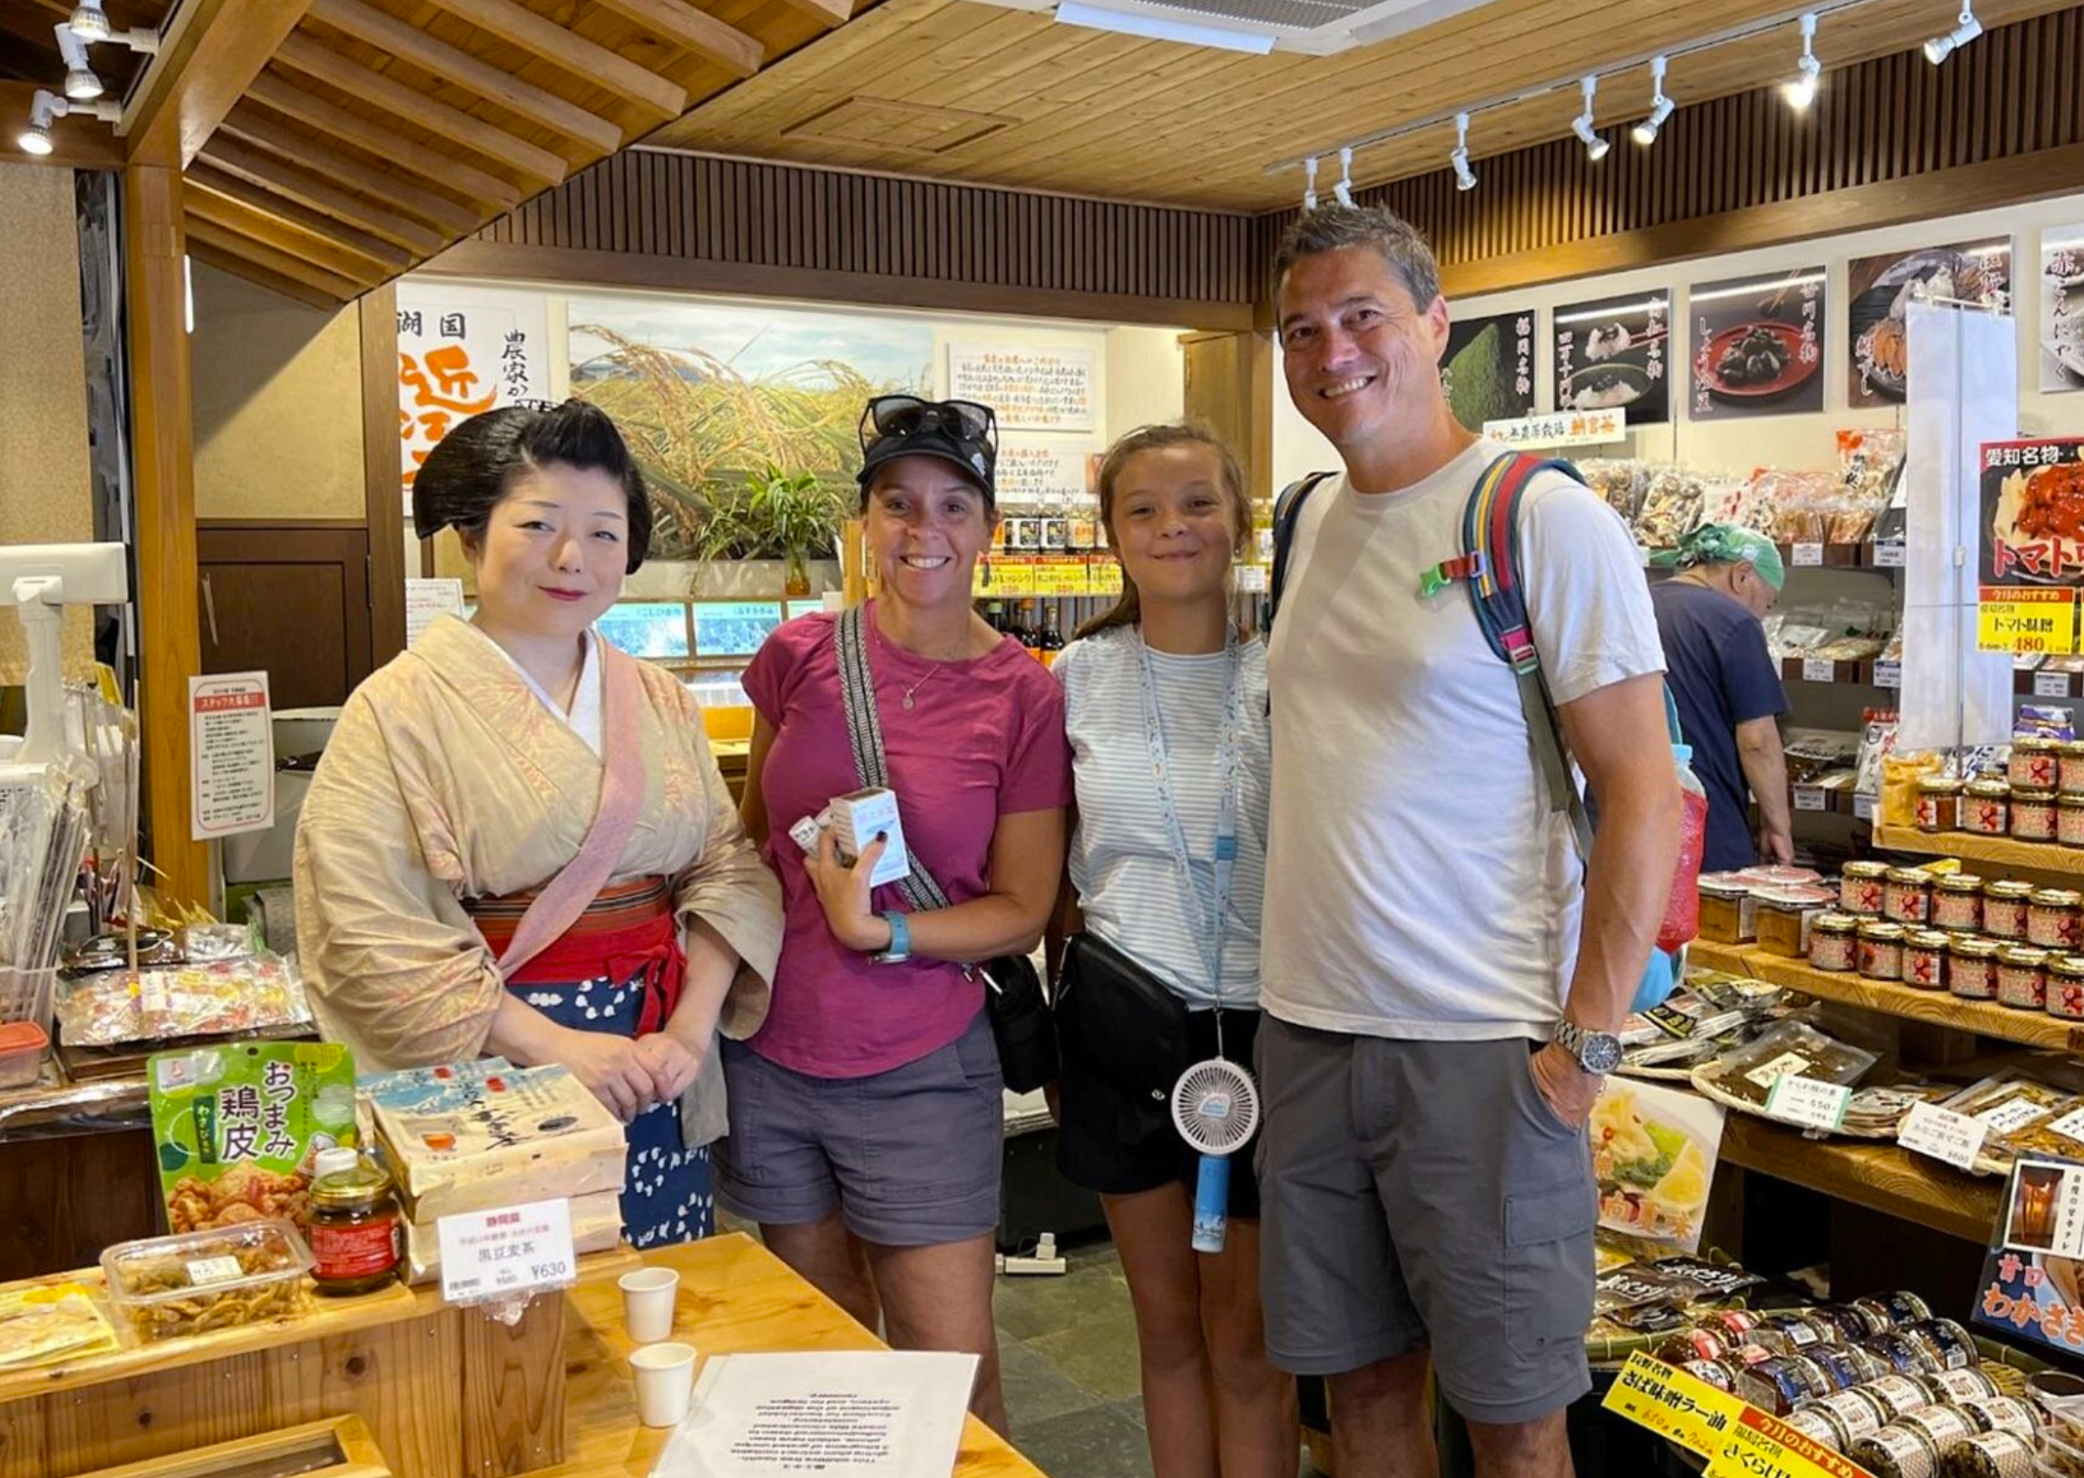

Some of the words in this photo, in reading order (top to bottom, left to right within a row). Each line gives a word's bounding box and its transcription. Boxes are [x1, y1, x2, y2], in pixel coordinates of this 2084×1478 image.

[396, 311, 466, 340] 湖国
[1994, 536, 2084, 577] トマト
[221, 1086, 260, 1161] 鶏皮
[263, 1062, 296, 1156] おつまみ
[531, 1262, 566, 1280] ¥630
[1622, 1369, 1728, 1432] さば味噌ラー油
[1759, 1418, 1853, 1478] 今月のおすすめ
